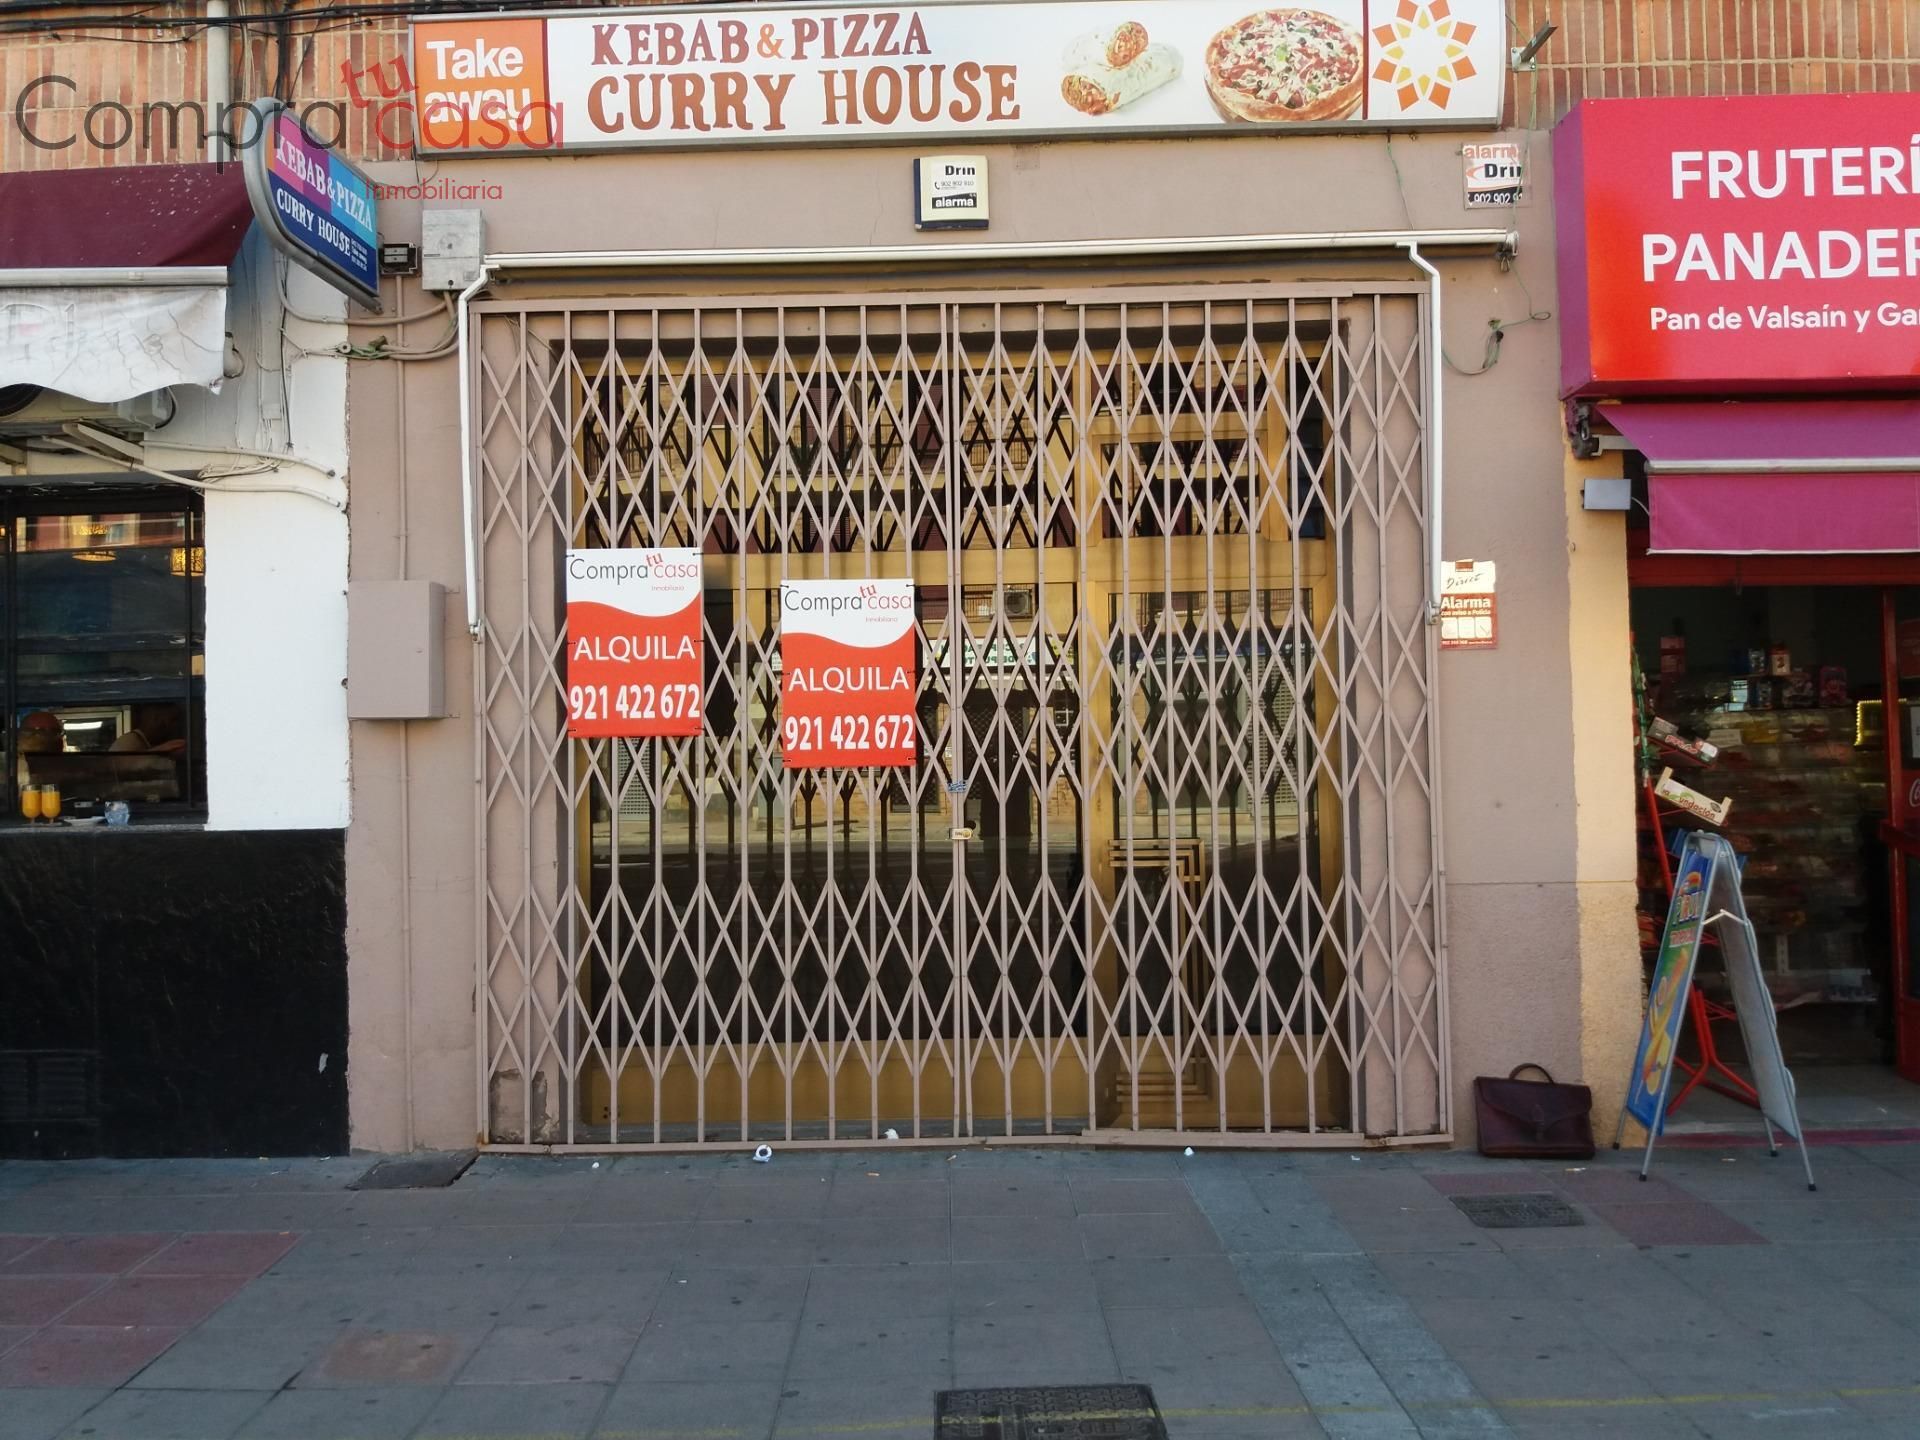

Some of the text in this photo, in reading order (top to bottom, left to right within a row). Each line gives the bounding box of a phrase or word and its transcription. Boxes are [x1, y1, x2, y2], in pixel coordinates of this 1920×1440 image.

[426, 38, 524, 80] Take
[424, 87, 532, 132] away
[587, 61, 1020, 133] CURRY HOUSE
[945, 165, 976, 176] Drin
[935, 197, 974, 208] alarma
[277, 188, 314, 232] CURRY
[318, 216, 351, 256] HOUSE
[1650, 307, 1700, 331] Pan
[1707, 306, 1742, 330] de
[1747, 303, 1847, 329] Valsaín
[1853, 309, 1870, 333] y
[569, 551, 699, 586] Compra tu casa
[784, 584, 913, 617] Compra tu casa
[1440, 597, 1491, 609] Alarma
[573, 635, 696, 663] ALQUILA
[788, 666, 910, 694] ALQUILA
[570, 684, 700, 721] 921 422 672
[785, 715, 914, 751] 921 422 672
